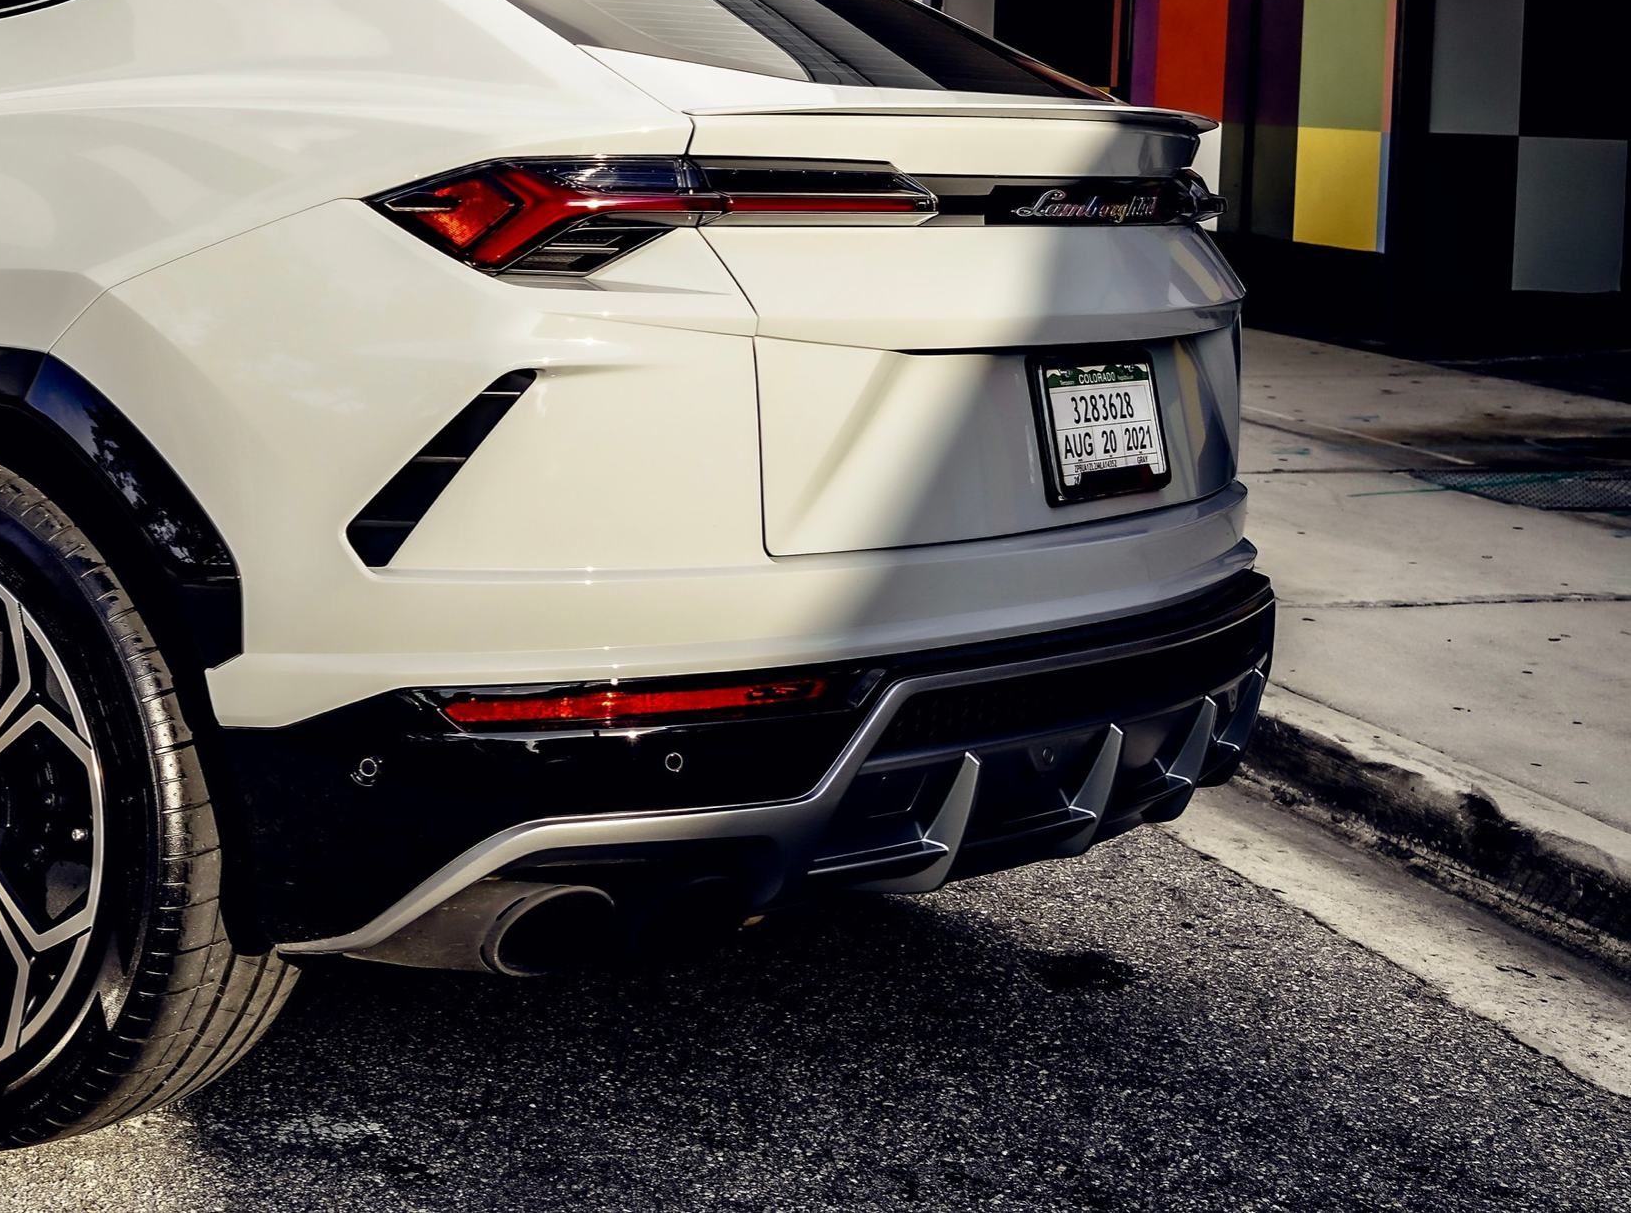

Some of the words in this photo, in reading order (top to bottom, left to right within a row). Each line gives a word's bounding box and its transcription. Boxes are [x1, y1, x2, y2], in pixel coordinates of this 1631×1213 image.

[1078, 371, 1116, 384] COLORADO
[1071, 391, 1134, 424] 3283628
[1064, 432, 1094, 460] AUG
[1101, 429, 1117, 454] 20
[1124, 425, 1153, 451] 2021
[1137, 456, 1148, 464] GRAY
